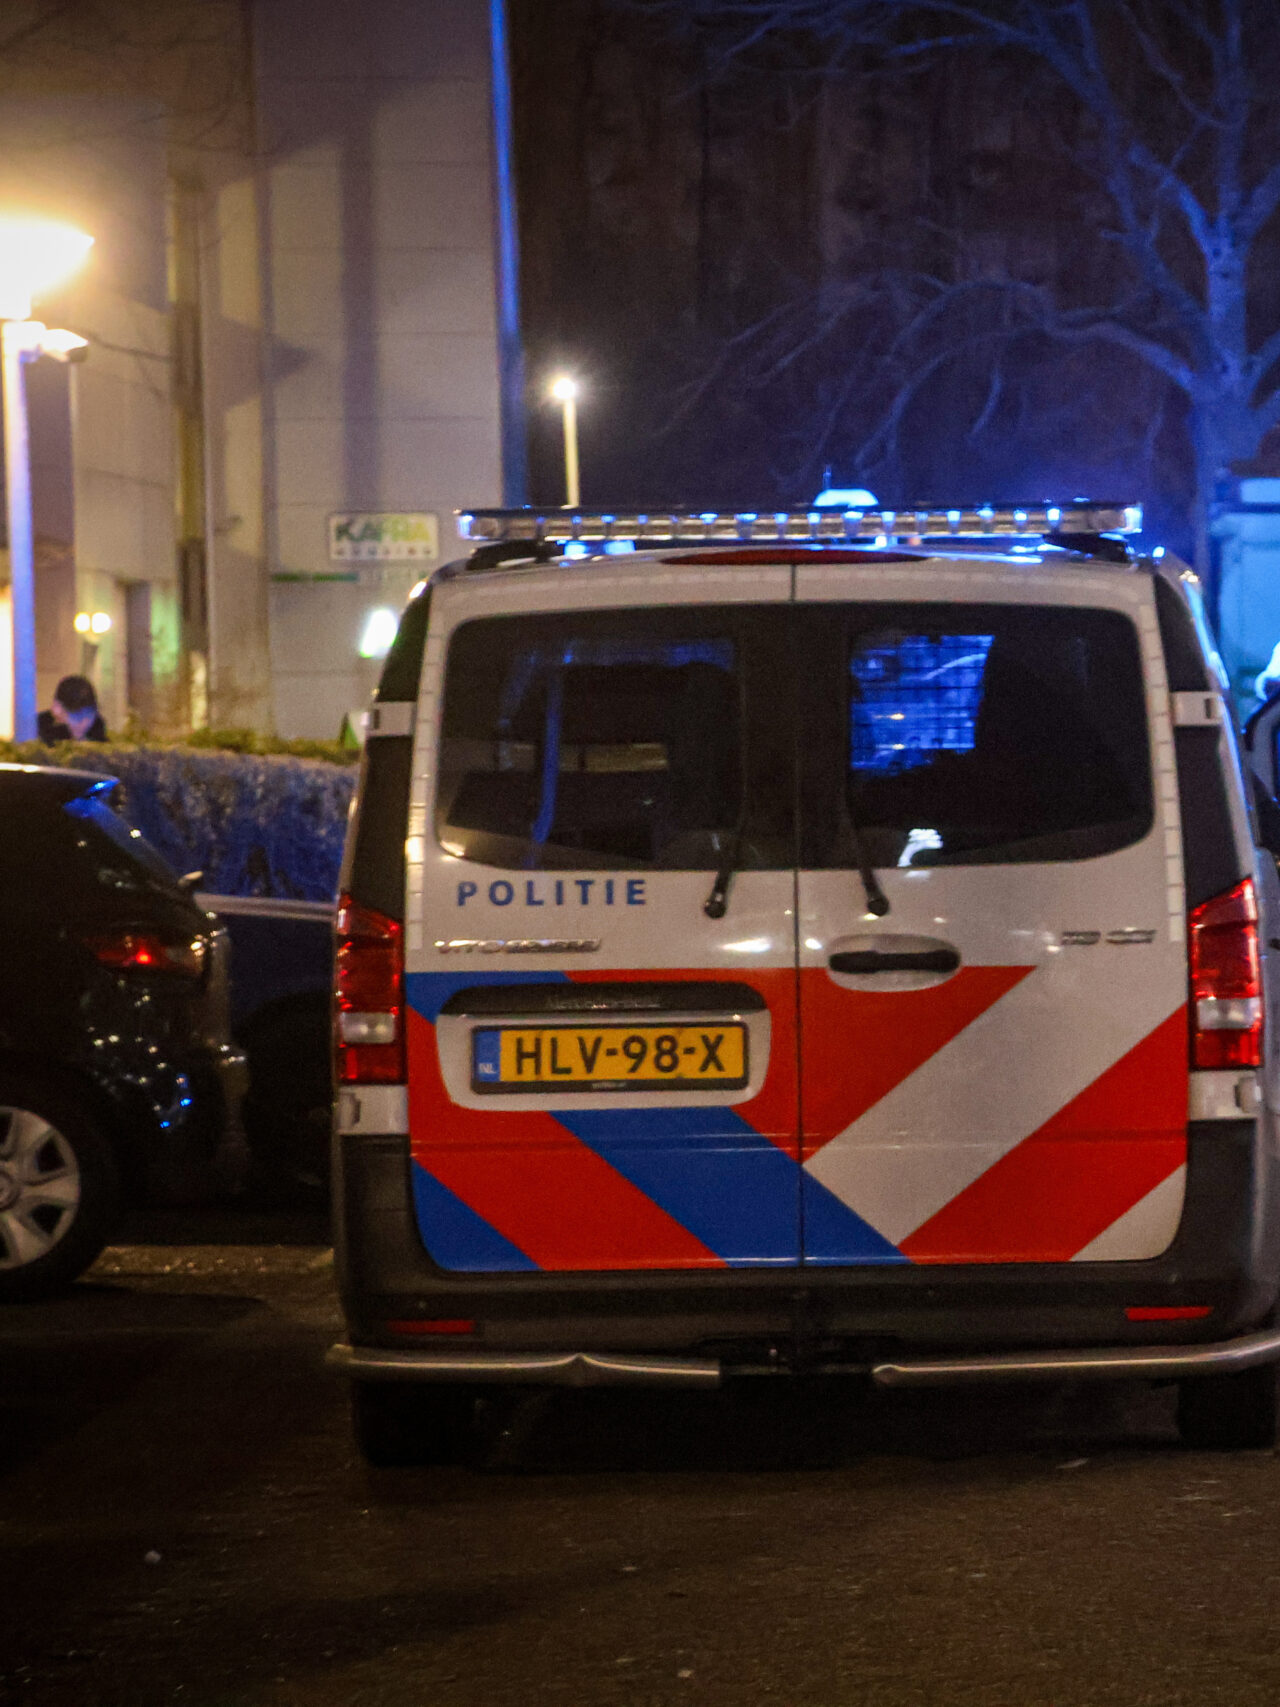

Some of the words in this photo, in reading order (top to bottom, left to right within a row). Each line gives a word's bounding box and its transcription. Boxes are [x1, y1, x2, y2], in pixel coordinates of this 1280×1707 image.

[457, 879, 647, 906] POLITIE
[479, 1062, 497, 1075] NL
[515, 1034, 725, 1076] HLV-98-X
